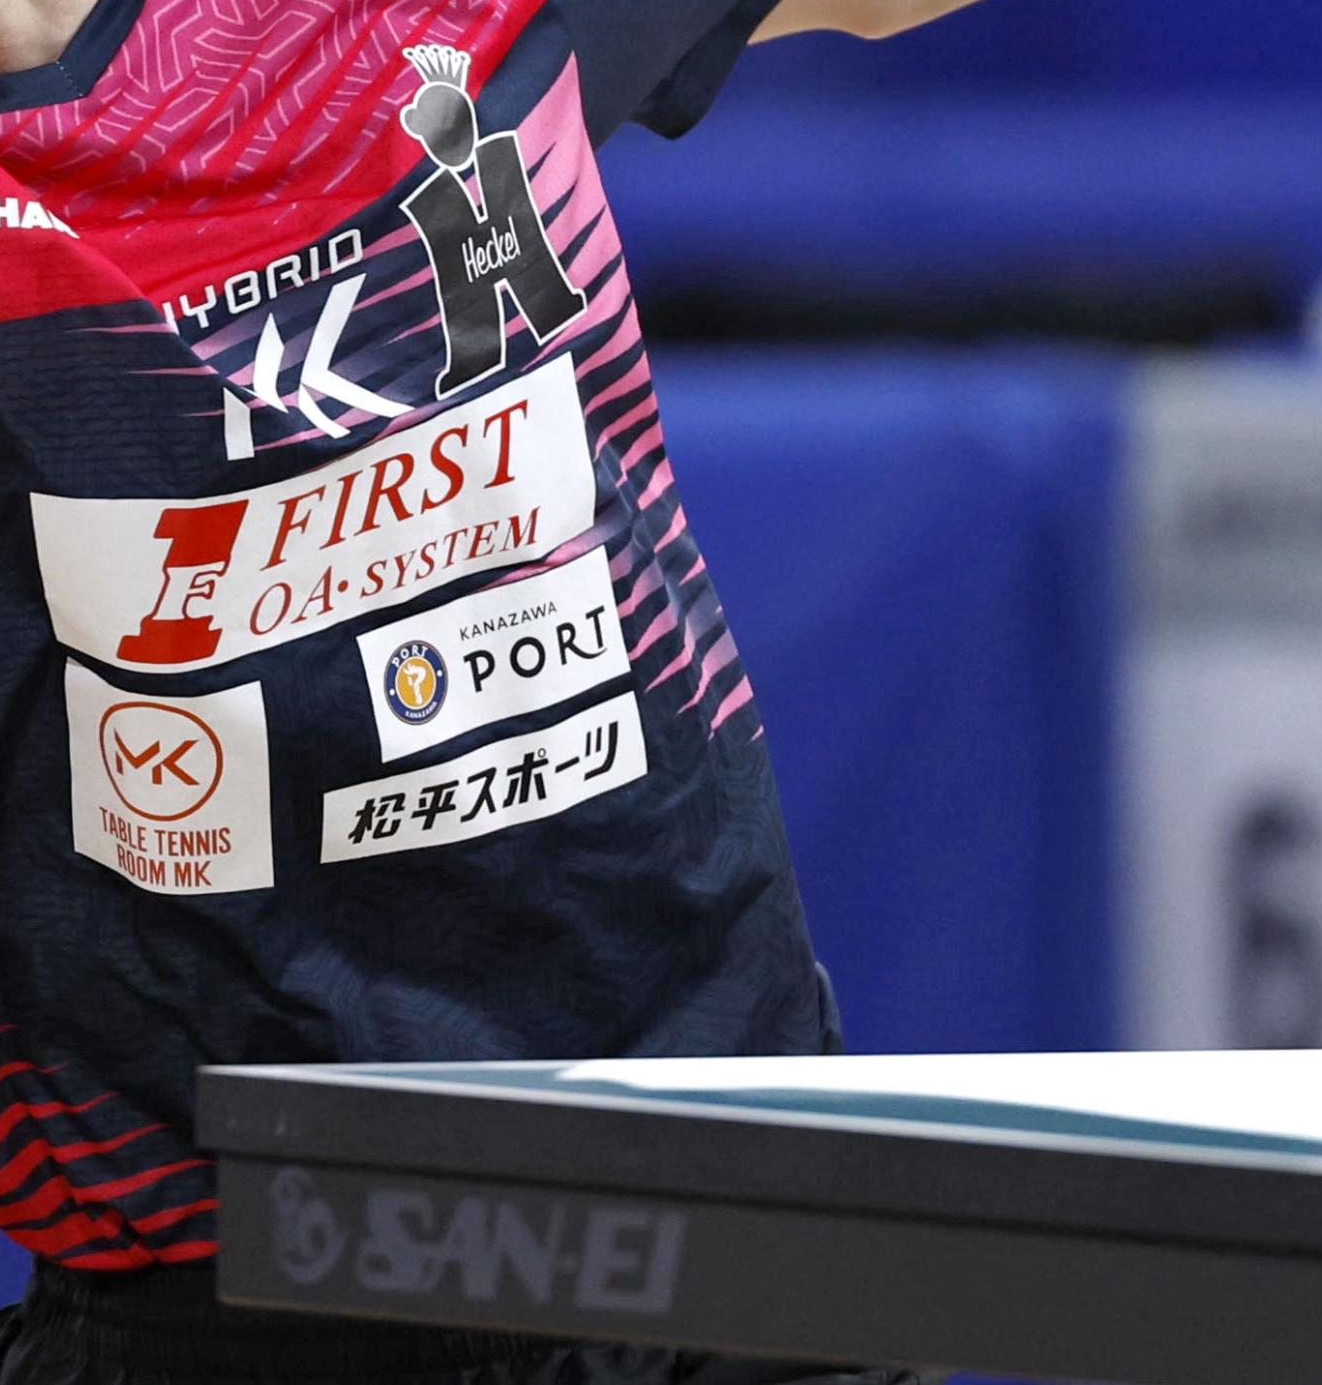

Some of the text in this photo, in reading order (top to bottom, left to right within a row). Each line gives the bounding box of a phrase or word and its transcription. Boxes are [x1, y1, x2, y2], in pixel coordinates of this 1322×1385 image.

[461, 215, 522, 284] Heckel
[260, 399, 529, 572] FIRST
[459, 601, 558, 642] KANAZAWA
[463, 605, 608, 693] PORT
[391, 644, 428, 668] PORT
[114, 728, 201, 786] MK
[348, 720, 619, 845] 松平スポーツ
[99, 806, 232, 857] TABLE TENNIS
[116, 843, 212, 888] ROOM MK
